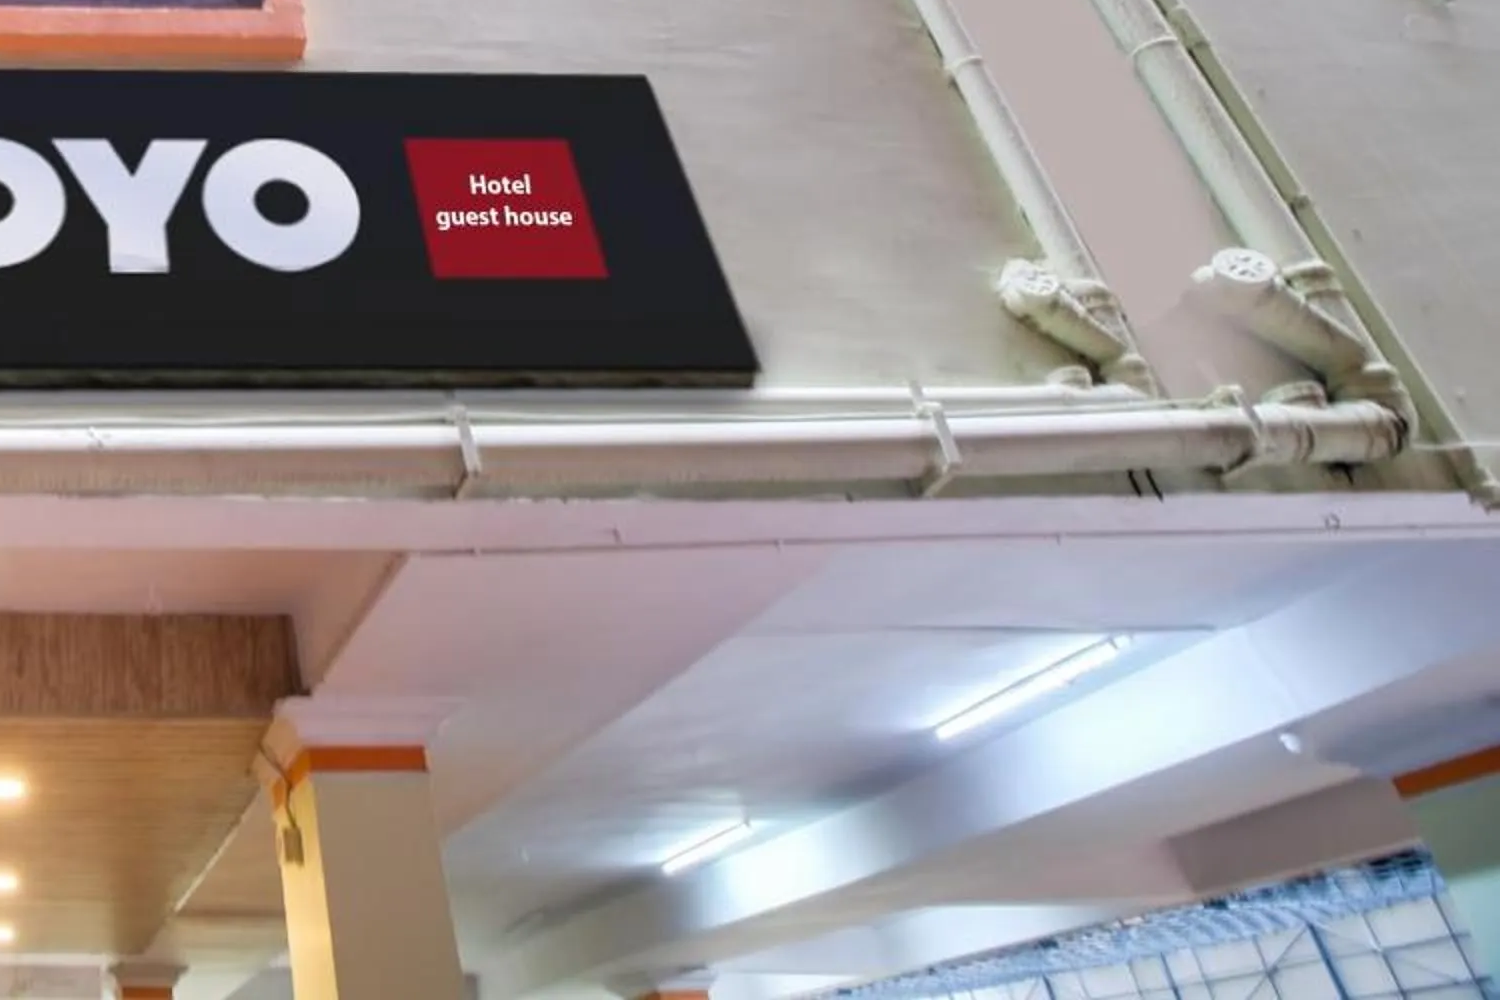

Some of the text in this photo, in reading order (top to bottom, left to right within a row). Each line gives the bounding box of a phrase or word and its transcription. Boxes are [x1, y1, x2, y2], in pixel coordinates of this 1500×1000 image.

[469, 173, 532, 195] Hotel
[435, 205, 573, 231] guest house
